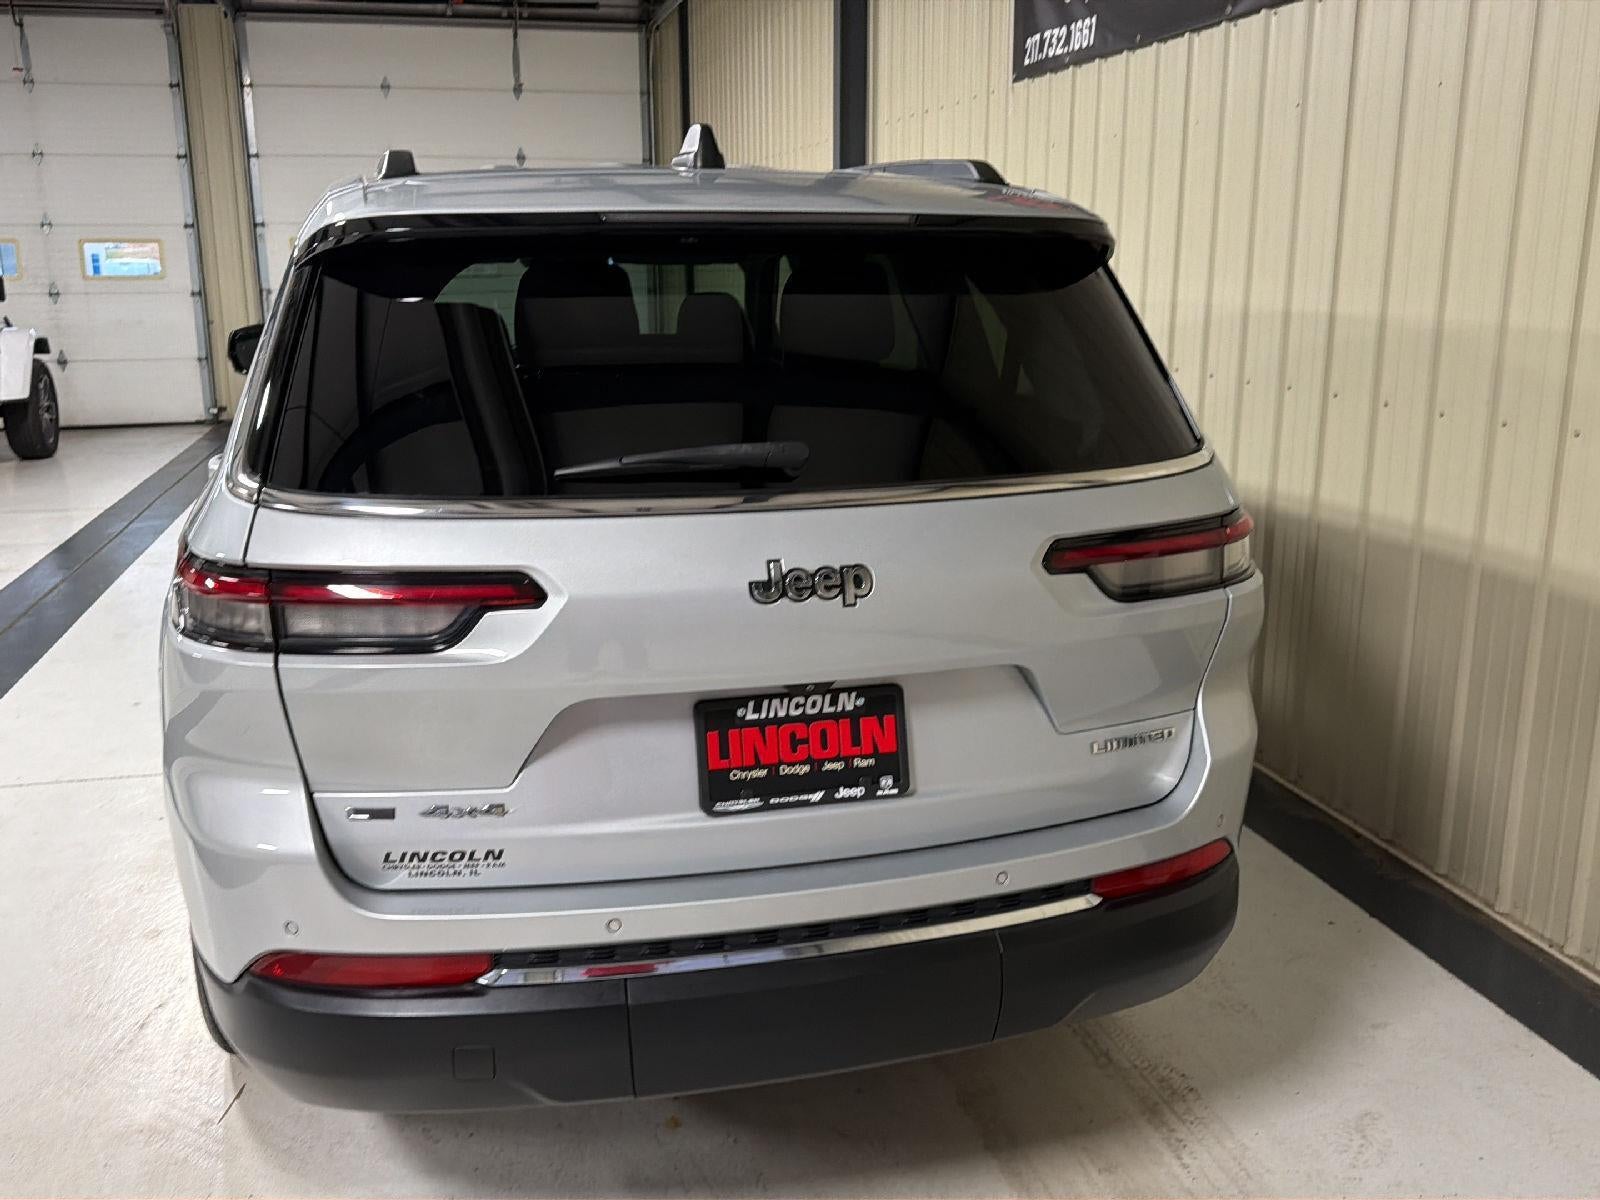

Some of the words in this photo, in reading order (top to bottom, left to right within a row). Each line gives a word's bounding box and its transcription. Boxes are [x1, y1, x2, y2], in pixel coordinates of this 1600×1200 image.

[1024, 14, 1097, 66] 217.732.1661
[748, 559, 873, 607] Jeep
[745, 691, 857, 721] LINCOLN
[706, 714, 898, 771] LINCOLN
[729, 768, 768, 781] Chrysler
[779, 763, 811, 776] Dodge
[821, 760, 845, 772] Jeep
[853, 757, 875, 768] Ram
[834, 786, 865, 799] Jeep
[382, 848, 505, 864] LINCOLN
